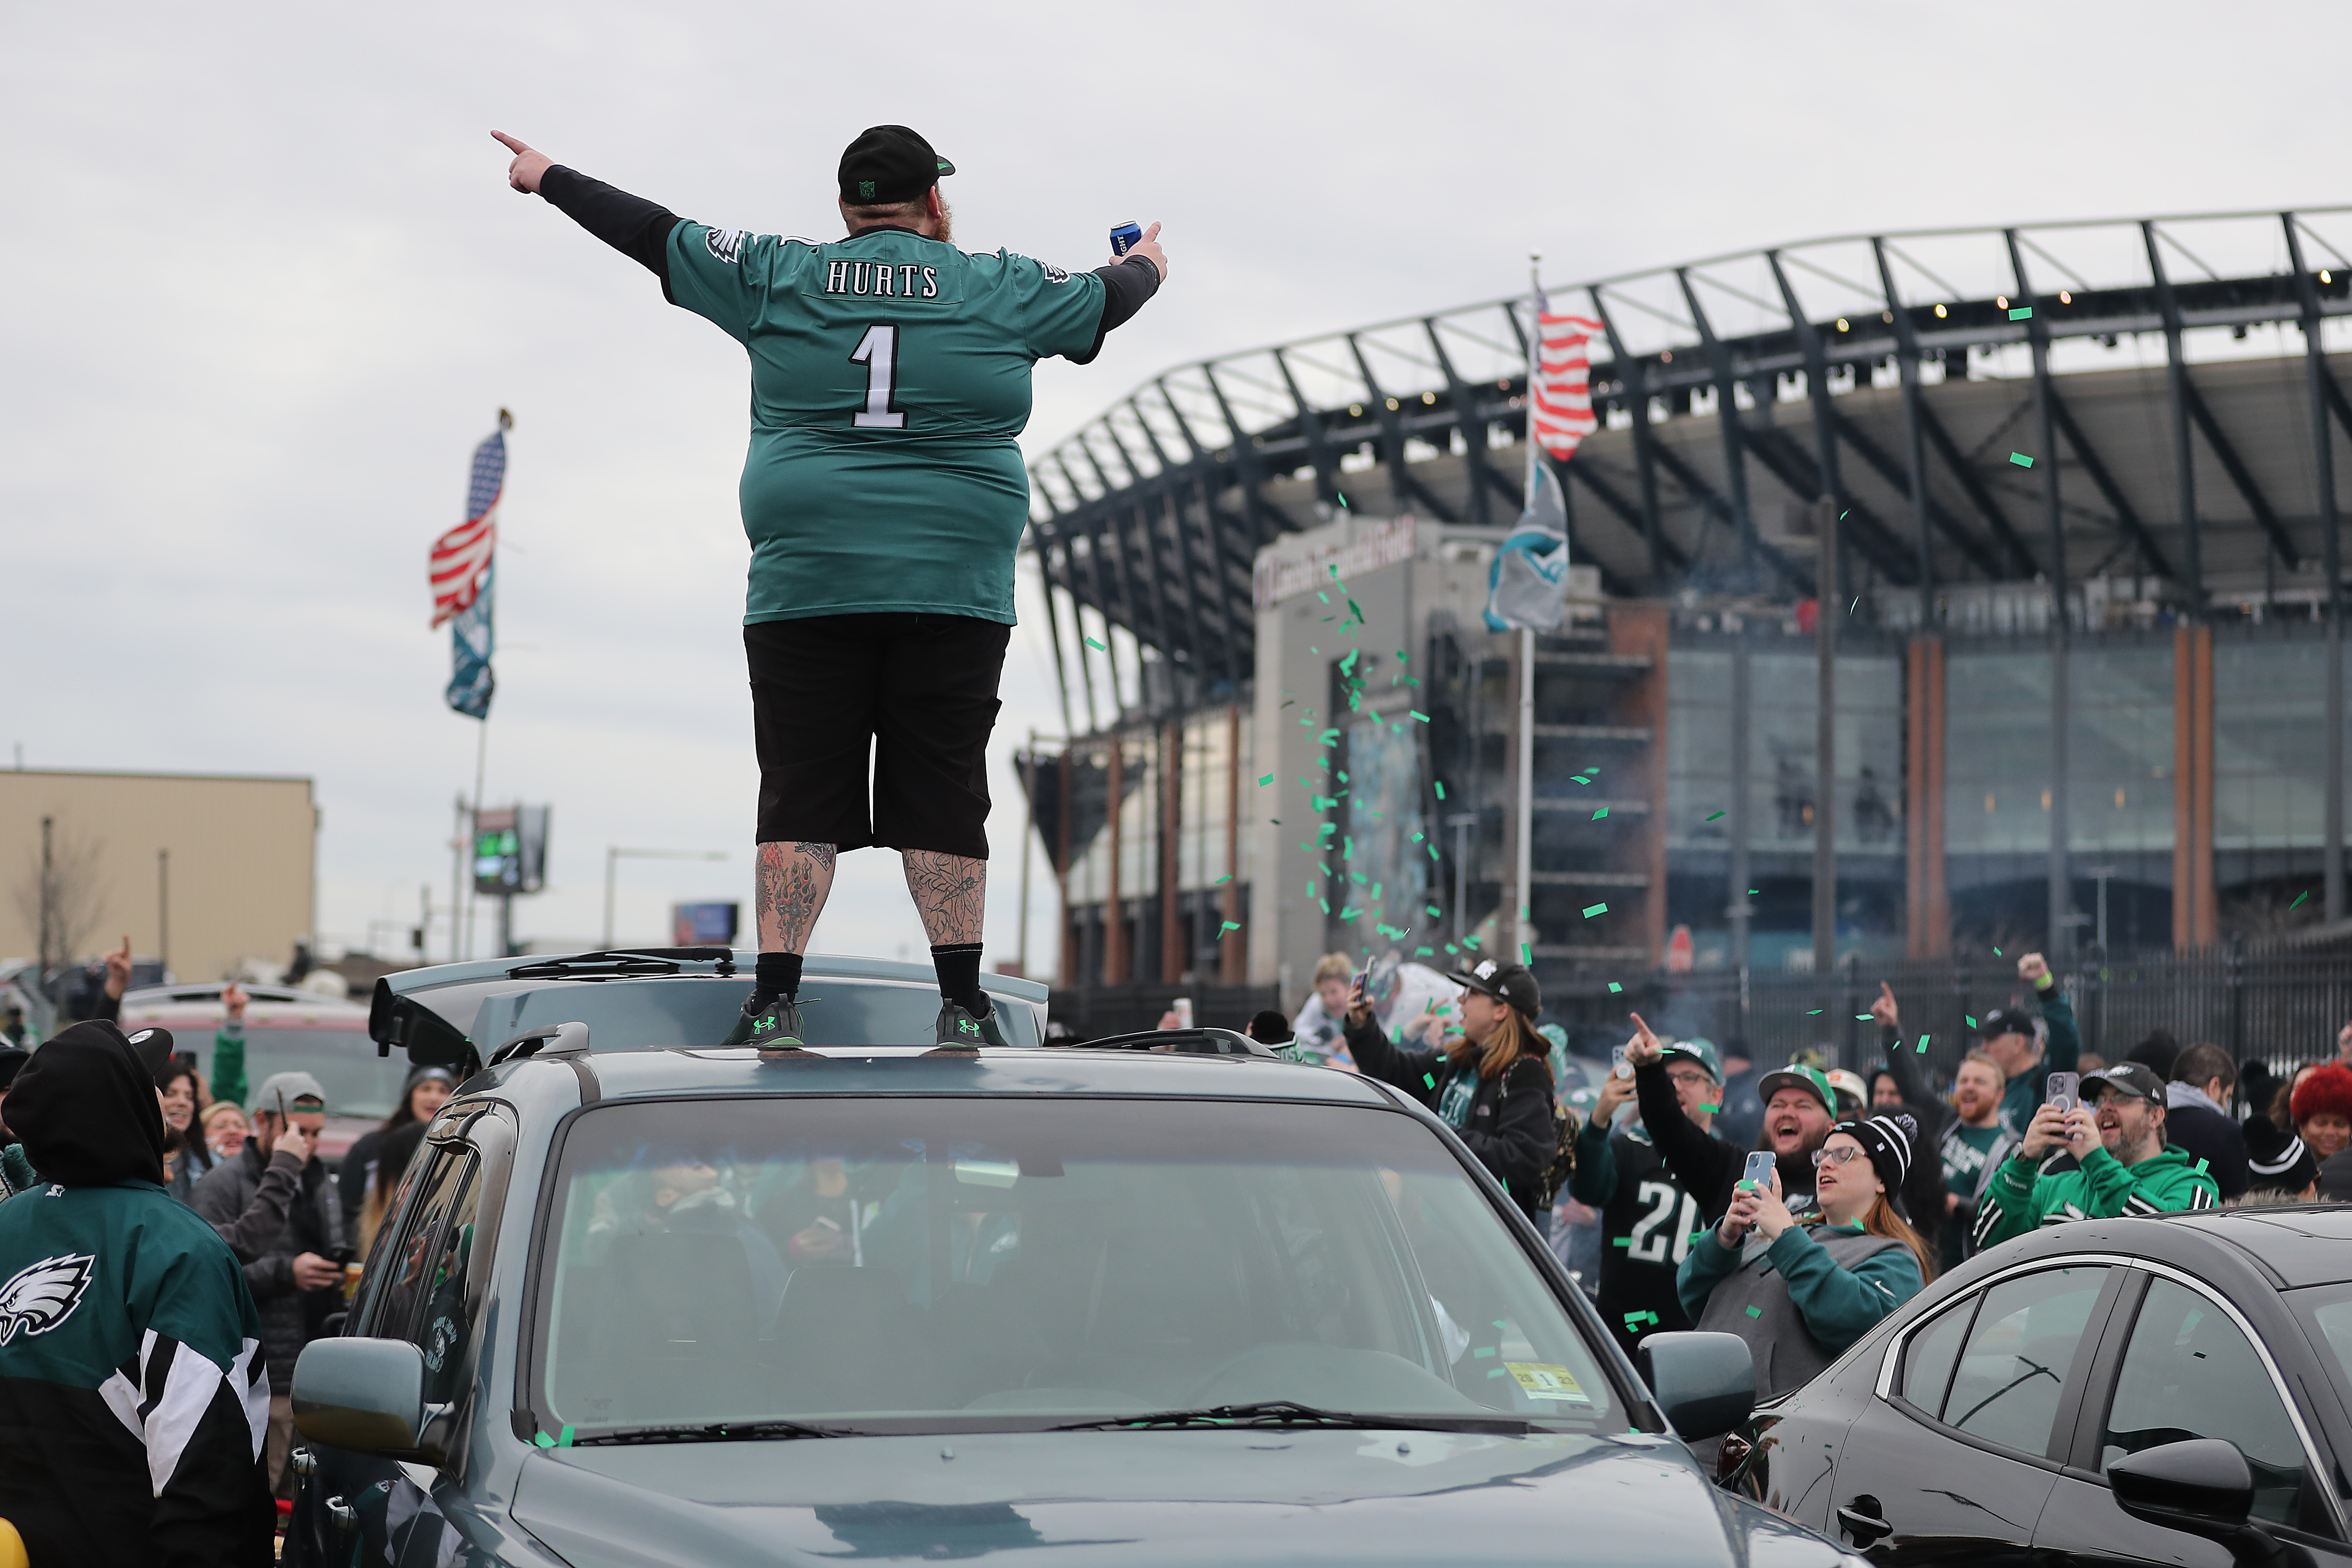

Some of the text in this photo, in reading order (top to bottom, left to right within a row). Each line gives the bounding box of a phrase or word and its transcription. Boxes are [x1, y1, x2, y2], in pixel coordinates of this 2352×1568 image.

[825, 262, 938, 298] HURTS
[849, 324, 907, 428] 1
[808, 846, 829, 869] FUNERAL
[1517, 1373, 1574, 1386] 20 1 23
